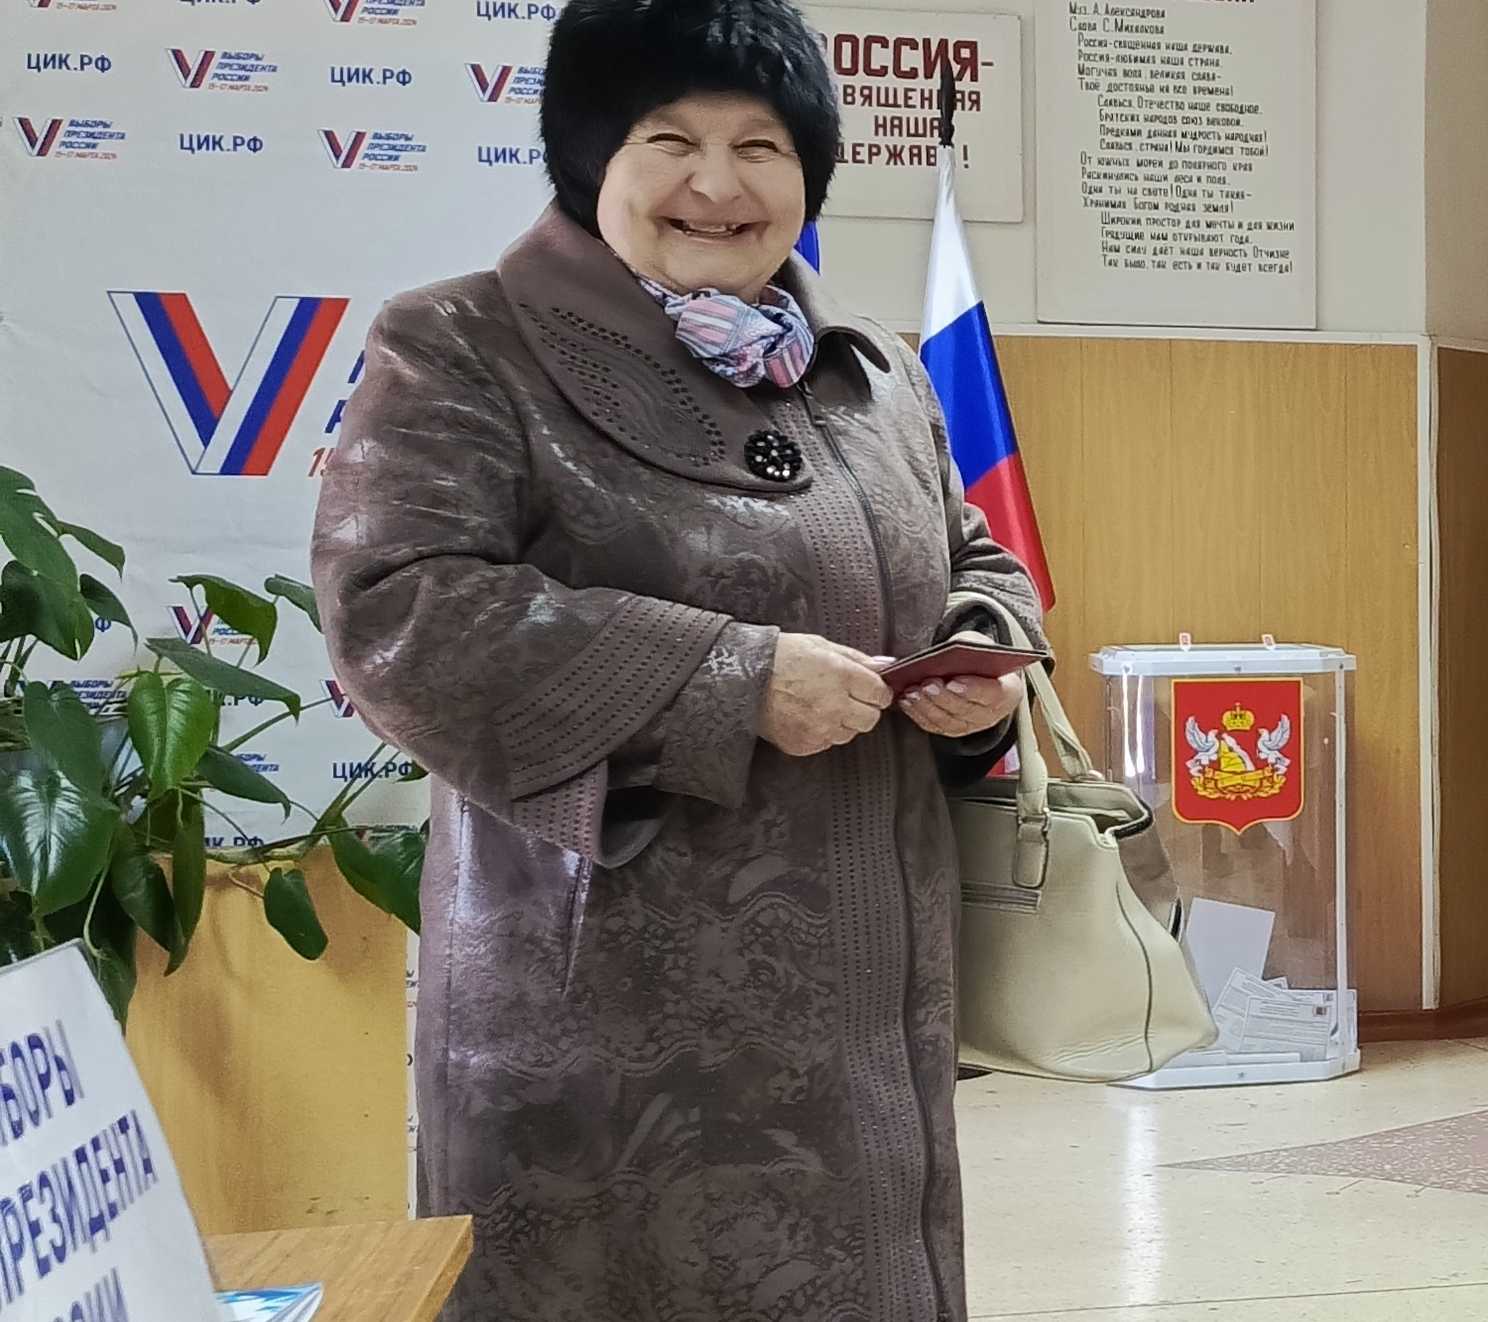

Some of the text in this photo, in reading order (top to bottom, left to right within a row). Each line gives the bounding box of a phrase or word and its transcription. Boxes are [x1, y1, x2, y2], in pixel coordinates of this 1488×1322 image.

[476, 0, 556, 21] ЦИК.РФ
[1069, 16, 1097, 31] Слова
[1165, 42, 1188, 52] наша
[27, 52, 112, 73] ЦИК.РФ
[1160, 56, 1184, 66] наша
[330, 65, 412, 87] ЦИК.РФ
[517, 66, 547, 75] ВЫБО
[1078, 63, 1117, 77] Могучая
[1150, 69, 1185, 80] великая
[1078, 77, 1100, 91] Твоё
[1106, 82, 1155, 93] достоянье
[1159, 84, 1170, 94] на
[1192, 85, 1233, 97] времена!
[1137, 95, 1185, 111] Отечество
[1188, 102, 1211, 112] наше
[1099, 108, 1140, 122] Братских
[1143, 113, 1178, 125] народов
[1181, 115, 1202, 126] союз
[1099, 123, 1142, 137] Предками
[1146, 129, 1178, 139] данная
[1181, 130, 1222, 141] мудрость
[179, 133, 263, 154] ЦИК.РФ
[1175, 141, 1190, 153] Мы
[1193, 144, 1234, 155] гордимся
[1240, 144, 1269, 157] тобой!
[1080, 150, 1253, 172] От южных морей до полярного края
[1081, 166, 1139, 181] Раскинулись
[1143, 173, 1168, 183] наши
[1174, 174, 1193, 184] леса
[1196, 175, 1203, 183] и
[1081, 181, 1103, 195] Одна
[1108, 185, 1121, 195] ты
[1127, 186, 1138, 196] на
[1175, 184, 1197, 199] Одна
[1201, 189, 1214, 199] ты
[1082, 196, 1234, 214] Хранимая Богом родная земля!
[1146, 217, 1181, 227] простор
[1185, 219, 1201, 229] для
[1205, 219, 1235, 230] мечты
[1237, 221, 1244, 230] и
[1246, 221, 1262, 231] для
[1265, 221, 1295, 232] жизни
[1101, 226, 1145, 241] Грядущие
[1150, 232, 1168, 241] нам
[1172, 233, 1224, 243] открывают
[1101, 240, 1290, 259] Нам силу даёт наша верность Отчизне
[1102, 254, 1118, 267] Так
[1151, 260, 1167, 269] так
[1172, 260, 1193, 270] есть
[1196, 261, 1202, 270] и
[1206, 261, 1220, 271] так
[1225, 262, 1252, 273] будет
[1258, 260, 1293, 274] всегда!
